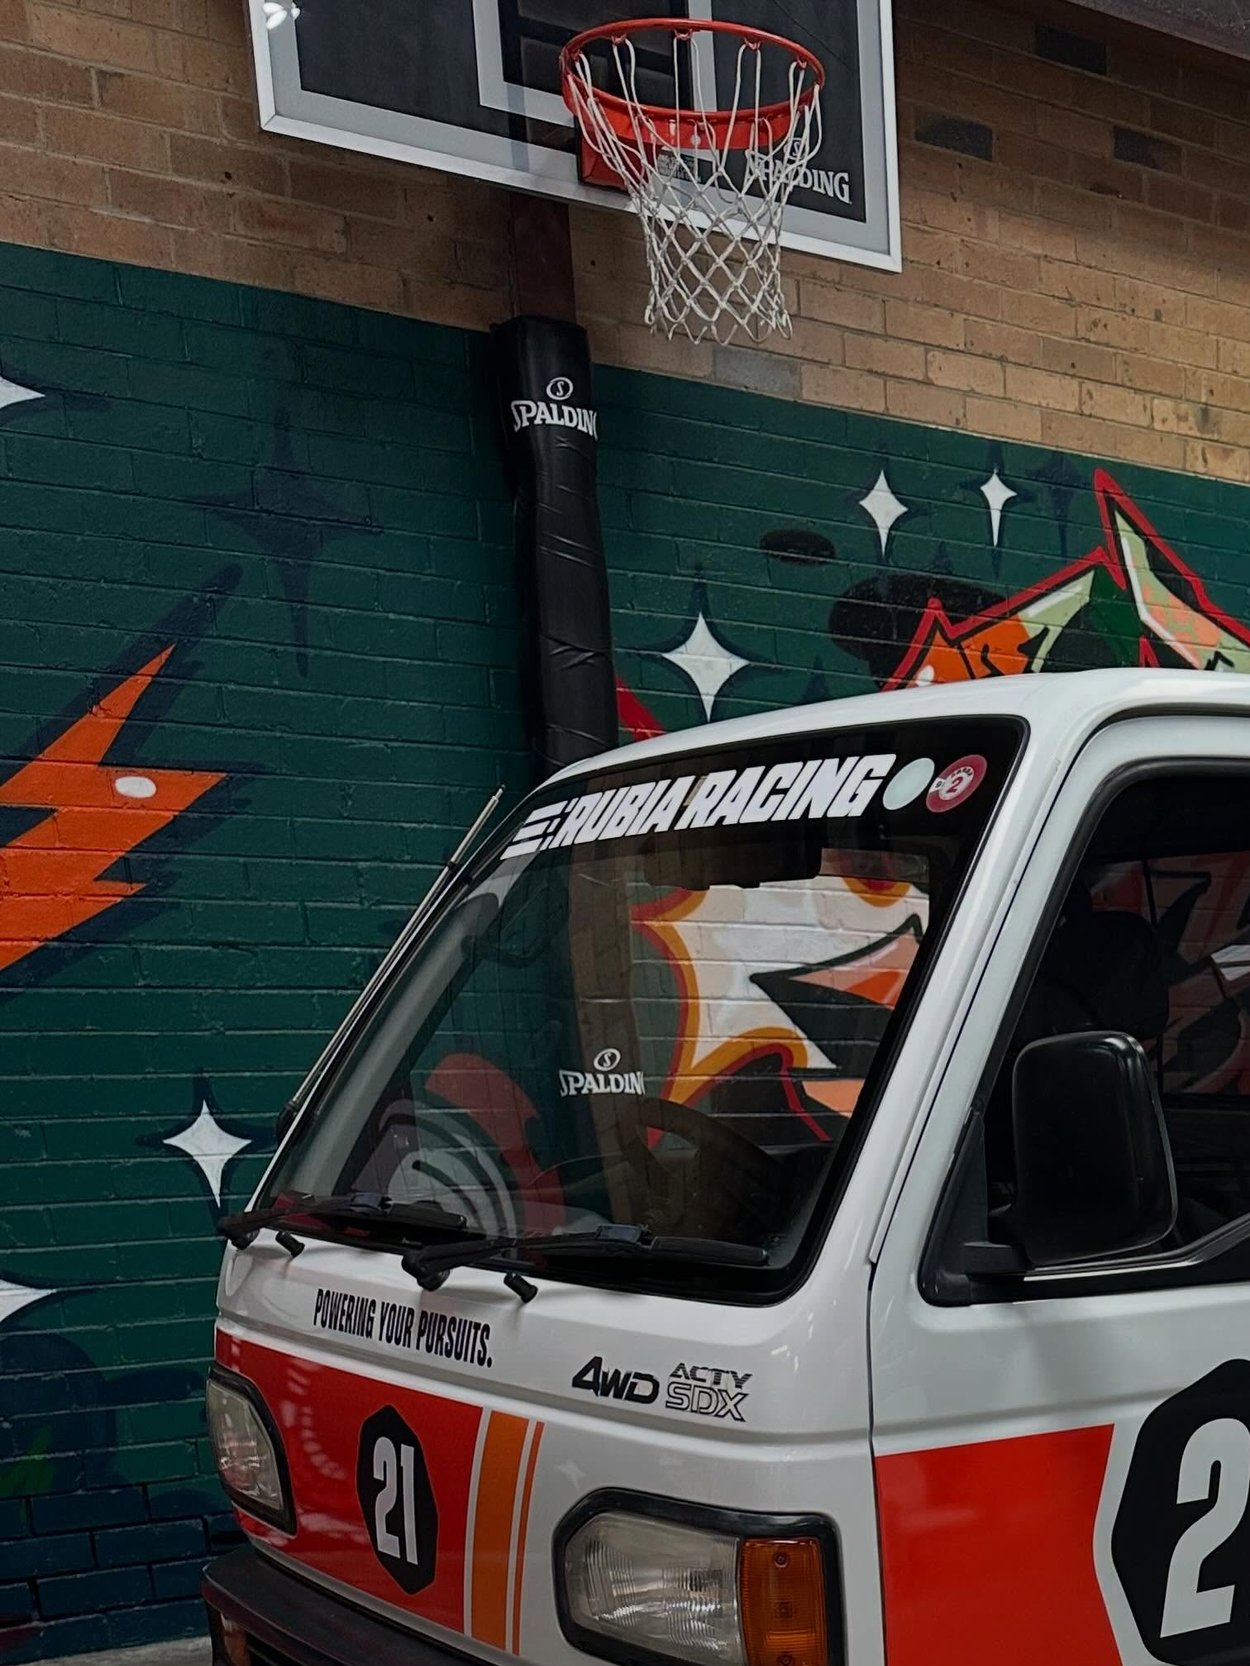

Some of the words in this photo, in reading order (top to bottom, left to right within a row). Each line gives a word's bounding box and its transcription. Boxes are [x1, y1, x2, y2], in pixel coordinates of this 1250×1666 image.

[511, 400, 598, 440] SPALDIN
[546, 775, 697, 851] RUBIA
[673, 753, 897, 832] RACING
[559, 1069, 646, 1098] SPALDIN
[313, 1288, 374, 1340] POWERING
[377, 1299, 415, 1349] YOUR
[415, 1308, 493, 1368] PURSUITS.
[571, 1356, 660, 1404] 4WD
[669, 1362, 753, 1389] ACTY
[665, 1381, 750, 1422] SDX
[372, 1436, 419, 1566] 21
